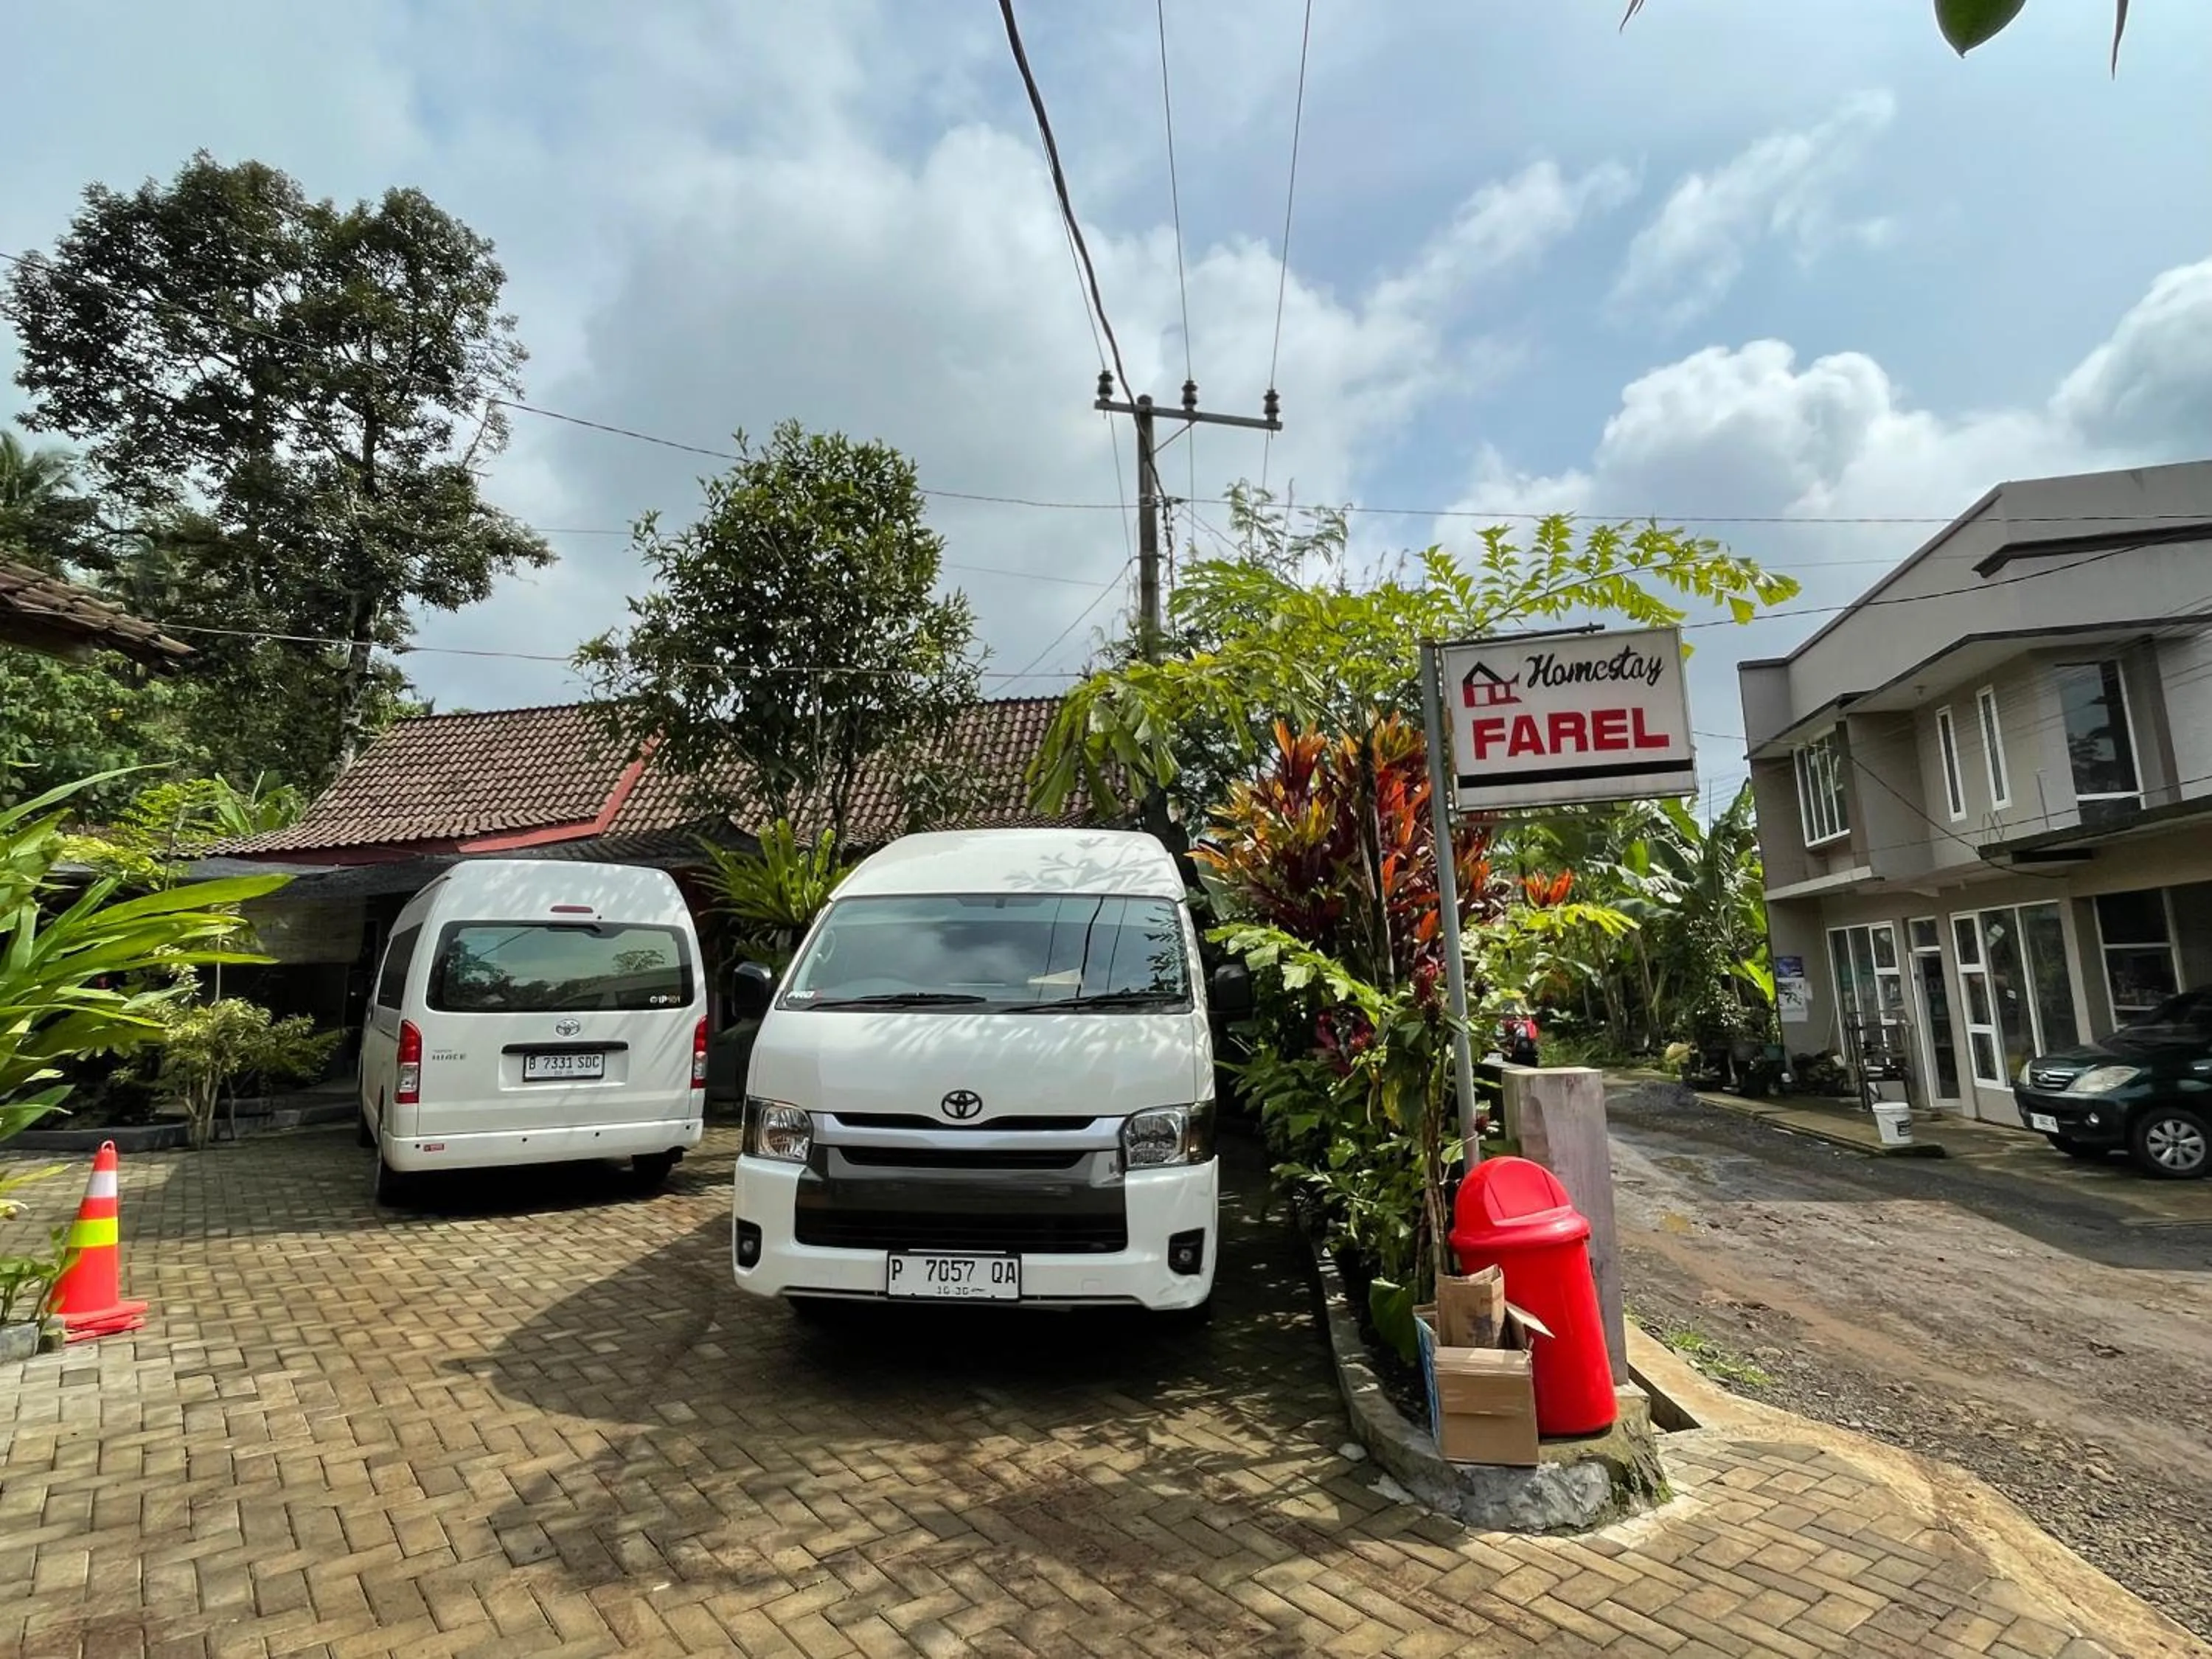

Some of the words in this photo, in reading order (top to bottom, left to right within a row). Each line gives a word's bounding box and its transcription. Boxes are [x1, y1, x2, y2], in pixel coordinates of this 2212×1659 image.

[1526, 644, 1664, 688] Homestay
[1472, 707, 1670, 760] FAREL
[529, 1057, 536, 1070] B
[543, 1057, 573, 1069] 7331
[577, 1055, 599, 1068] SDC
[891, 1259, 903, 1281] P
[925, 1259, 975, 1282] 7057
[992, 1262, 1016, 1284] QA
